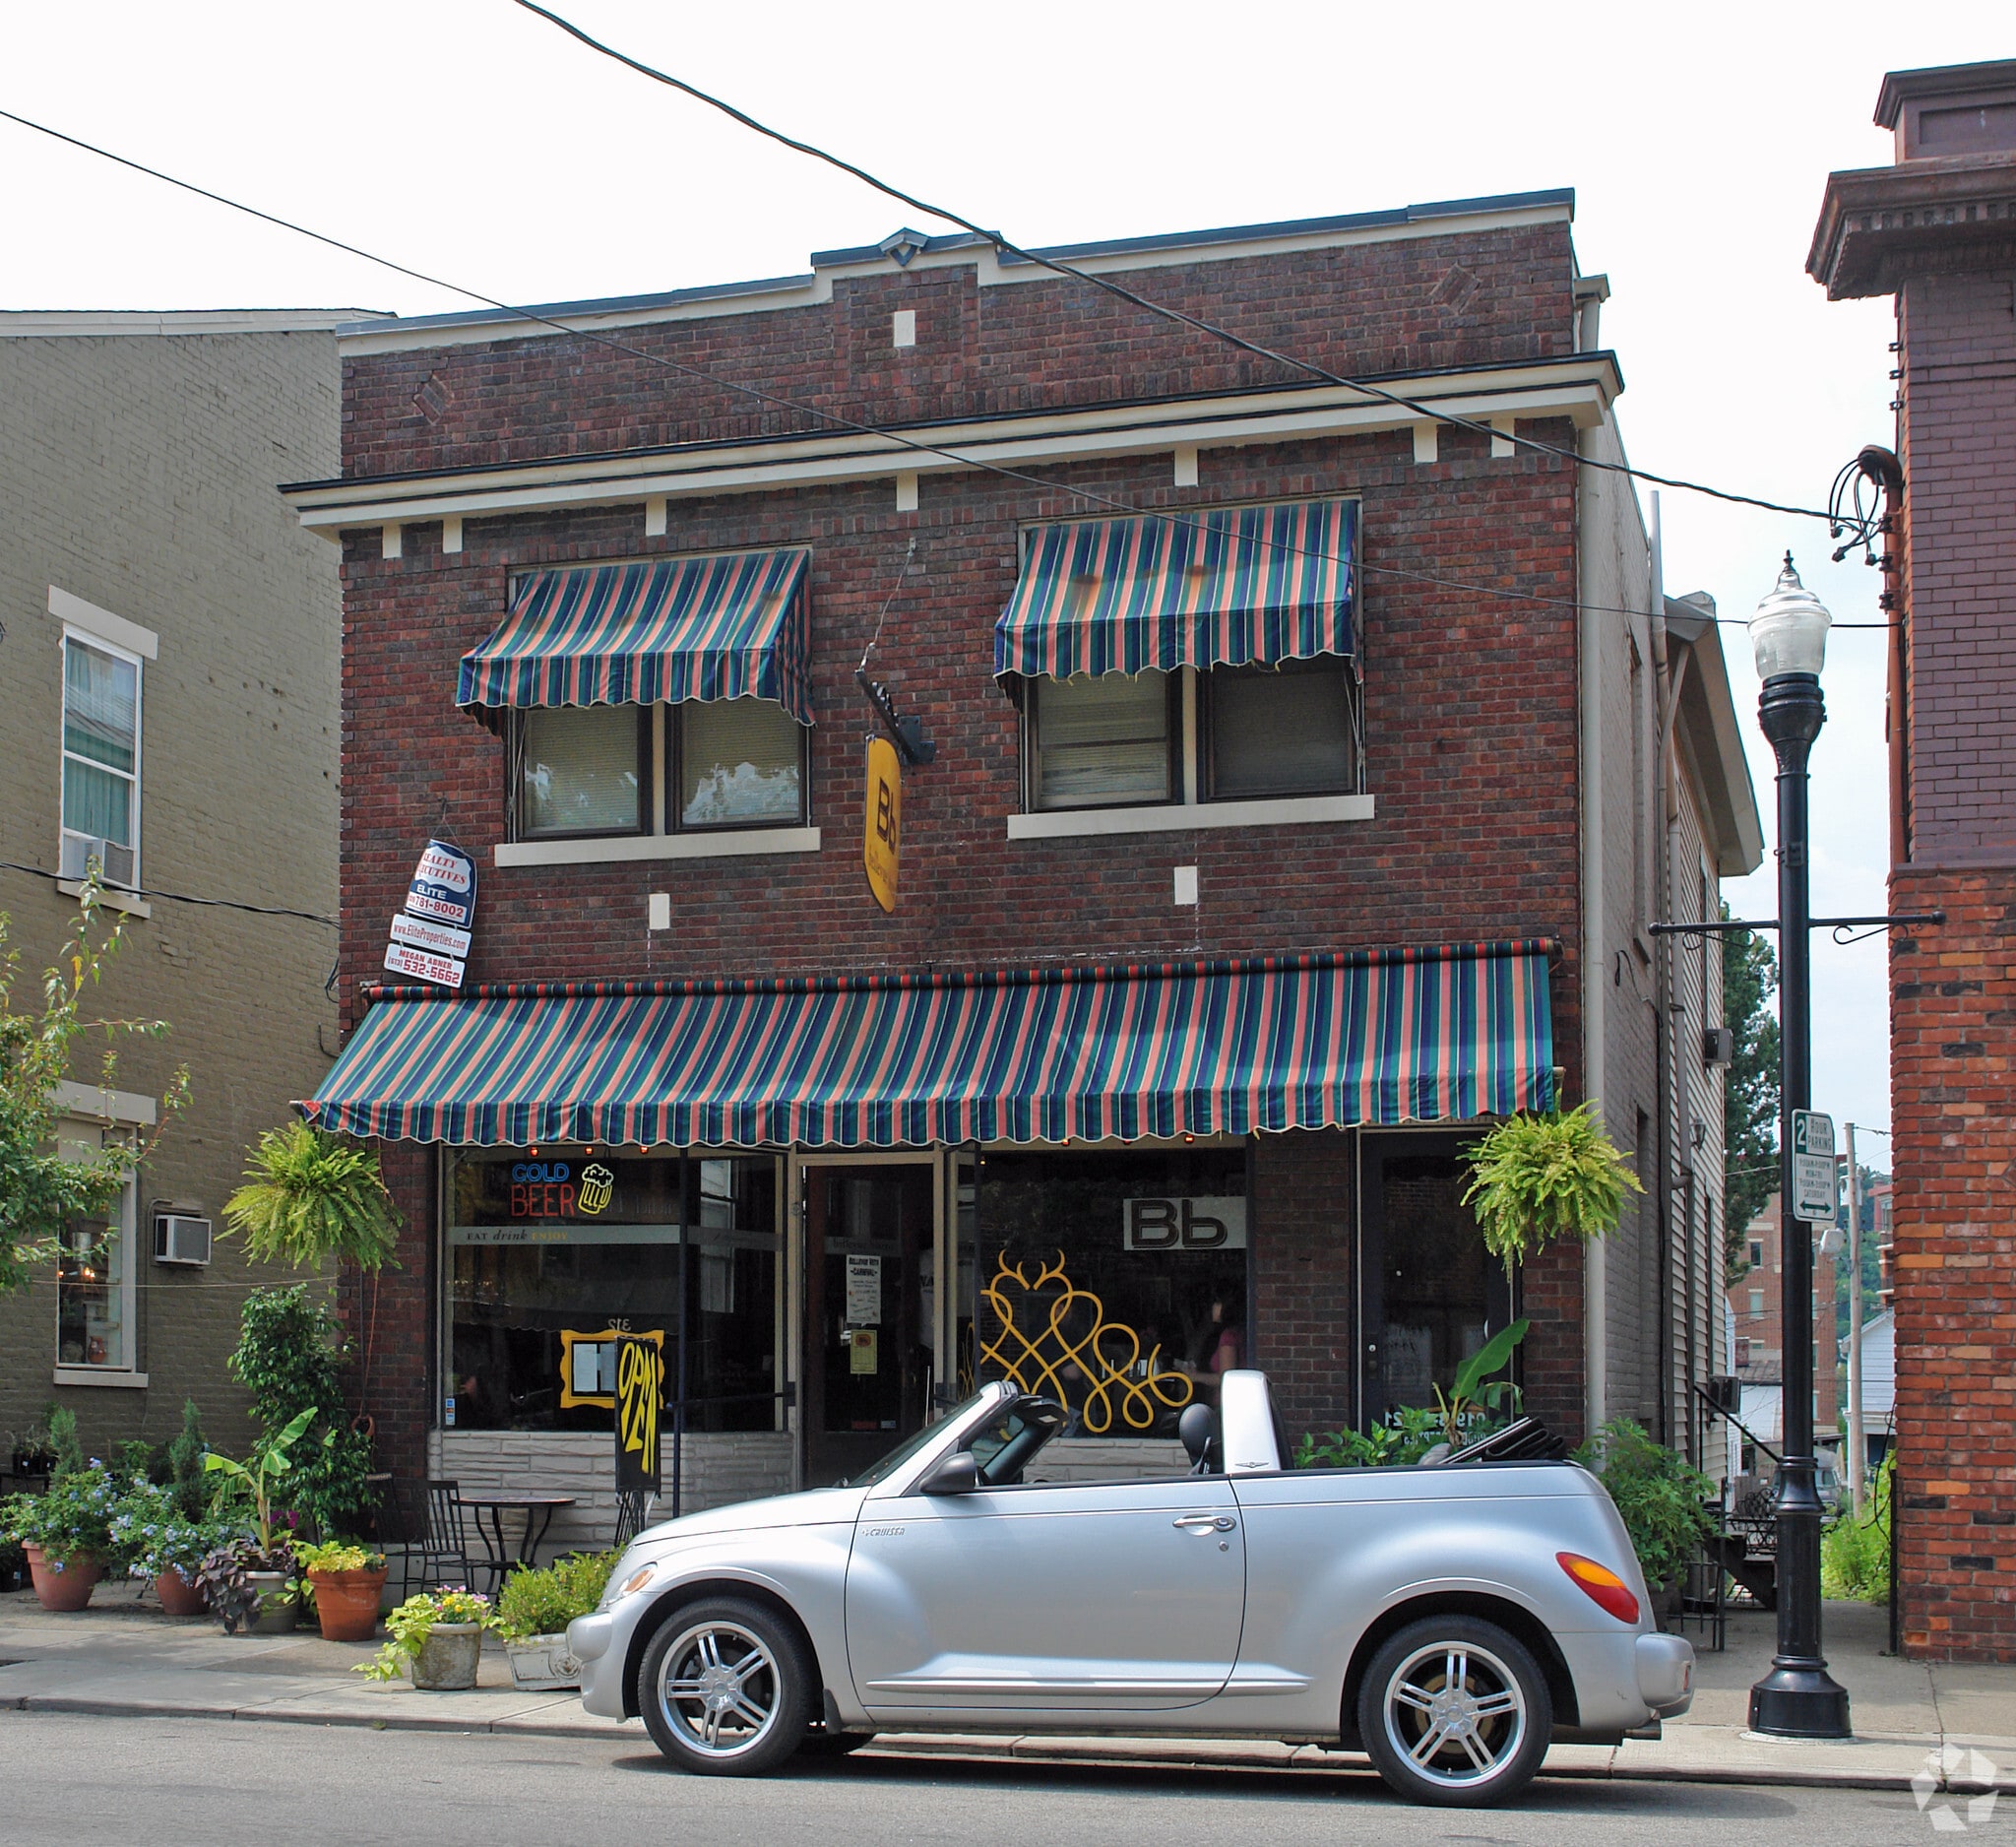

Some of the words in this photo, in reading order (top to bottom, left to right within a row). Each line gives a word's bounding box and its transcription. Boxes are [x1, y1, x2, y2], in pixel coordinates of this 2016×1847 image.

[416, 884, 447, 900] ELITE
[415, 896, 464, 918] 781-8002
[403, 960, 460, 985] 532-5662
[1796, 1118, 1806, 1146] 2
[1808, 1135, 1832, 1150] PARKING
[511, 1164, 570, 1182] COLD
[510, 1184, 576, 1217] BEER
[1131, 1199, 1228, 1249] Bb
[493, 1230, 528, 1241] drink
[532, 1232, 568, 1242] ENJOY
[618, 1342, 656, 1478] OPEN
[870, 1527, 905, 1537] CRUISER
